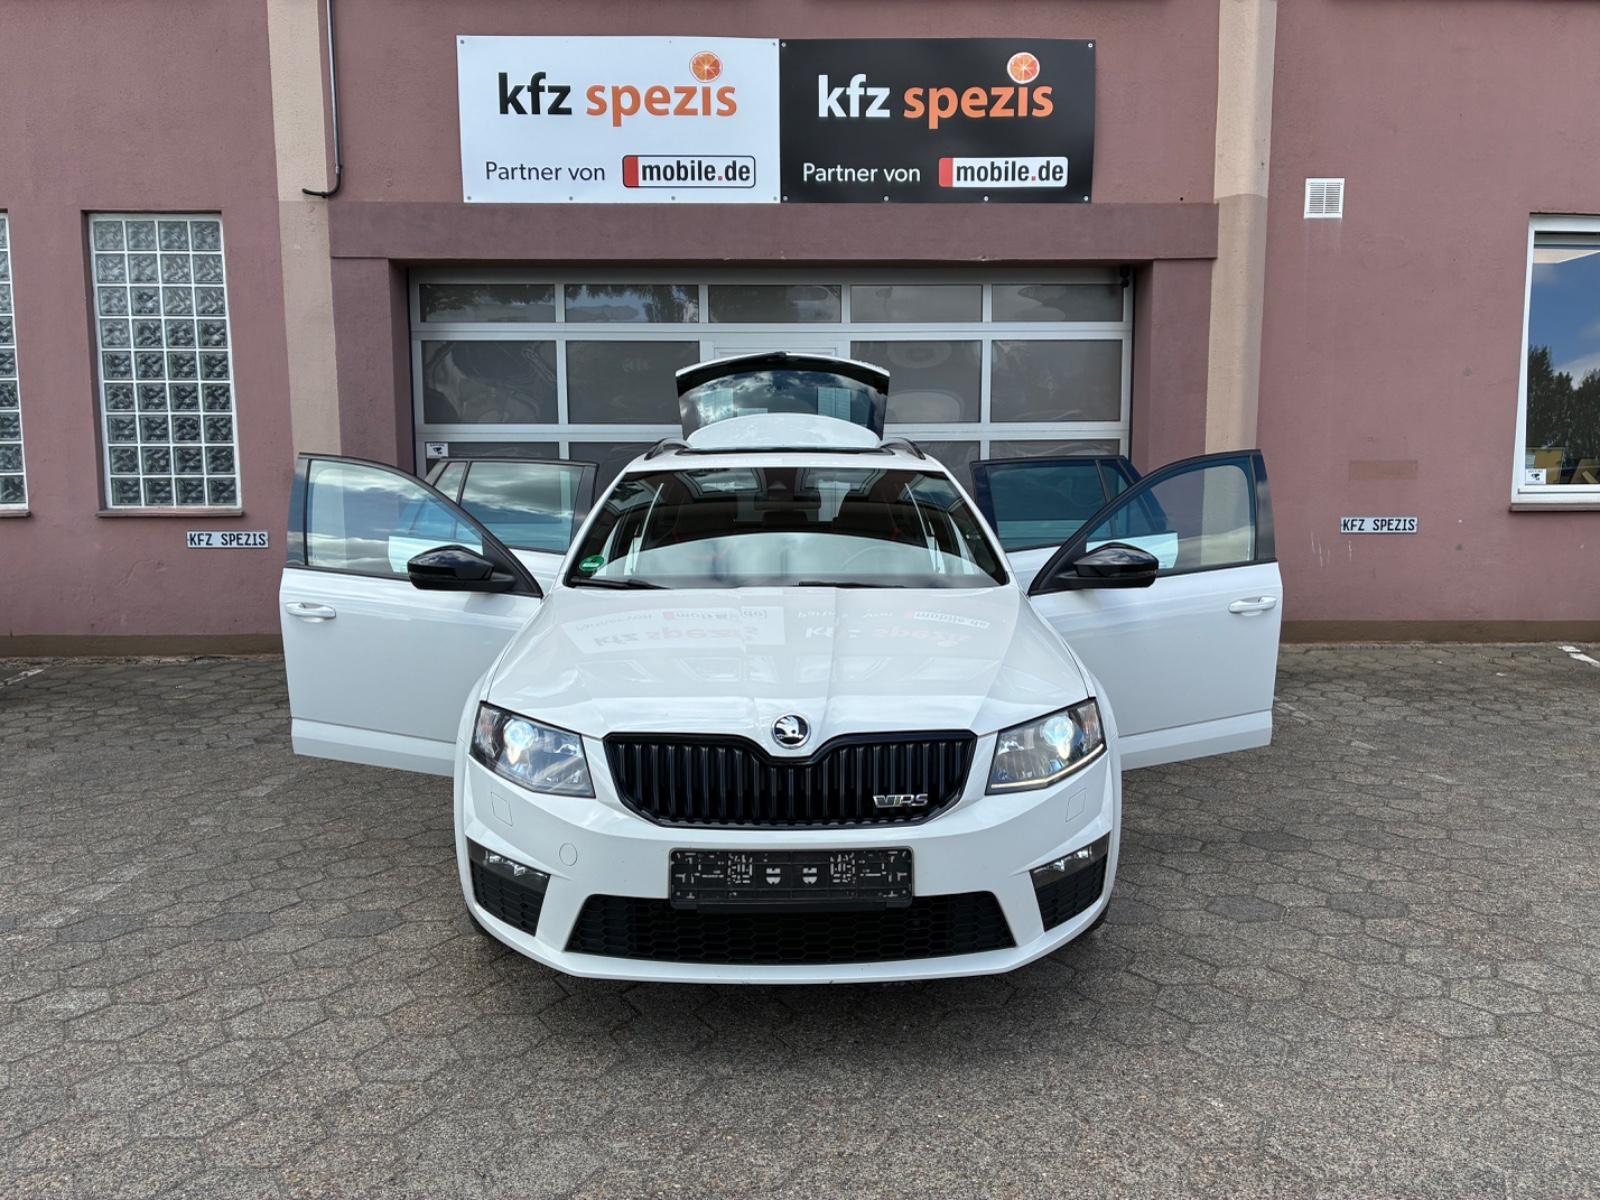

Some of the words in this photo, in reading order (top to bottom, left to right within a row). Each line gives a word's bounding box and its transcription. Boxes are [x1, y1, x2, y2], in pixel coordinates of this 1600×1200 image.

[498, 72, 573, 116] kfz
[585, 84, 738, 127] spezis
[818, 73, 891, 119] kfz
[903, 85, 1055, 129] spezis
[485, 160, 562, 182] Partner
[568, 167, 606, 182] von
[641, 159, 751, 182] mobile.de
[802, 162, 878, 183] Partner
[884, 169, 921, 183] von
[955, 160, 1064, 183] mobile.de
[1342, 518, 1366, 532] KFZ
[1372, 518, 1416, 532] SPEZIS
[189, 532, 214, 547] KFZ
[220, 532, 267, 547] SPEZIS
